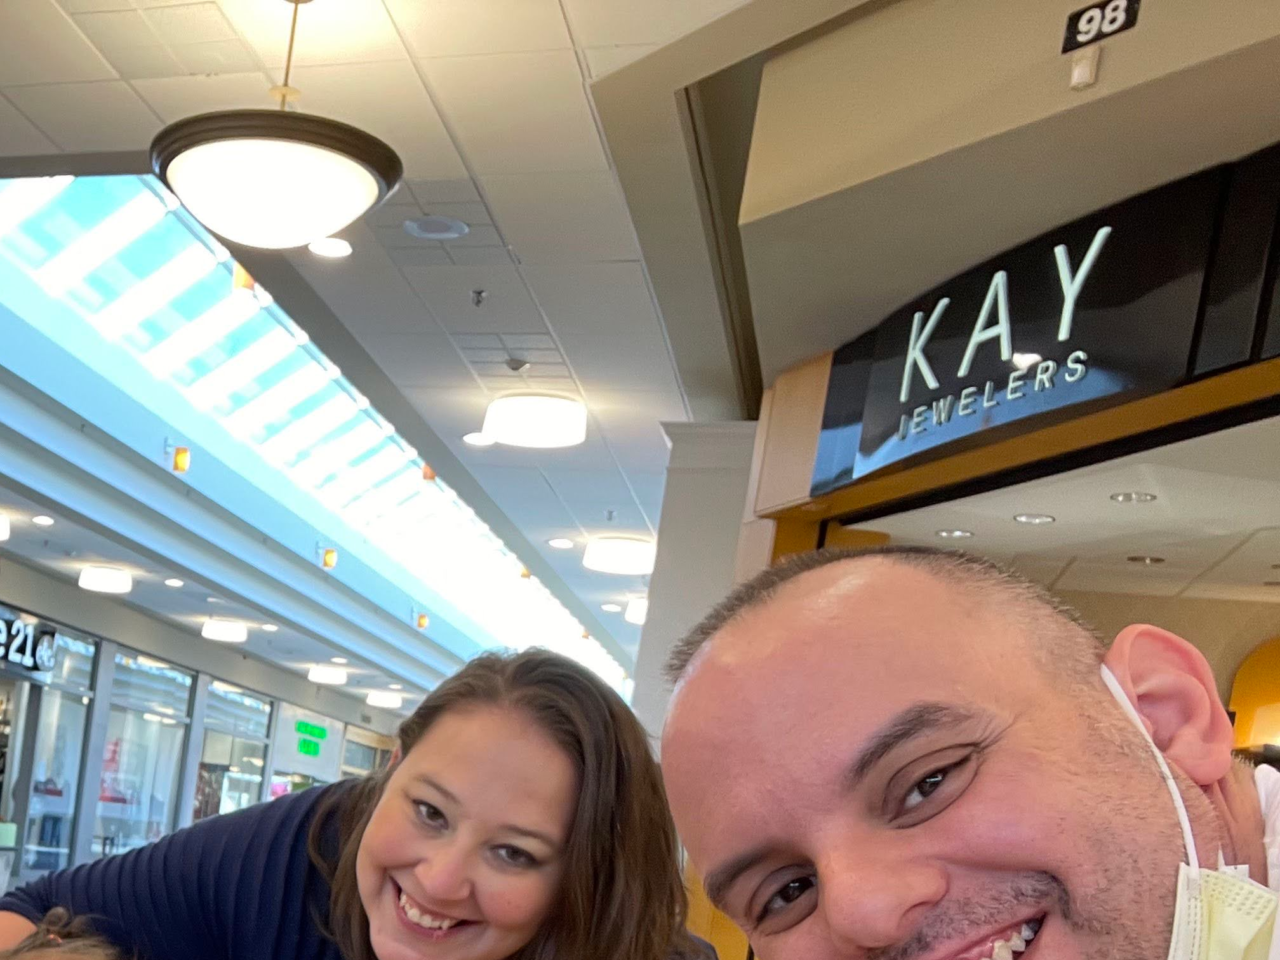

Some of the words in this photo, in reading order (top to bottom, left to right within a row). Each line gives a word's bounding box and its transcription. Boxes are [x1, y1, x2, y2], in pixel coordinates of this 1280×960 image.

[1076, 0, 1127, 43] 98
[899, 225, 1113, 404] KAY
[895, 350, 1088, 441] JEWELERS
